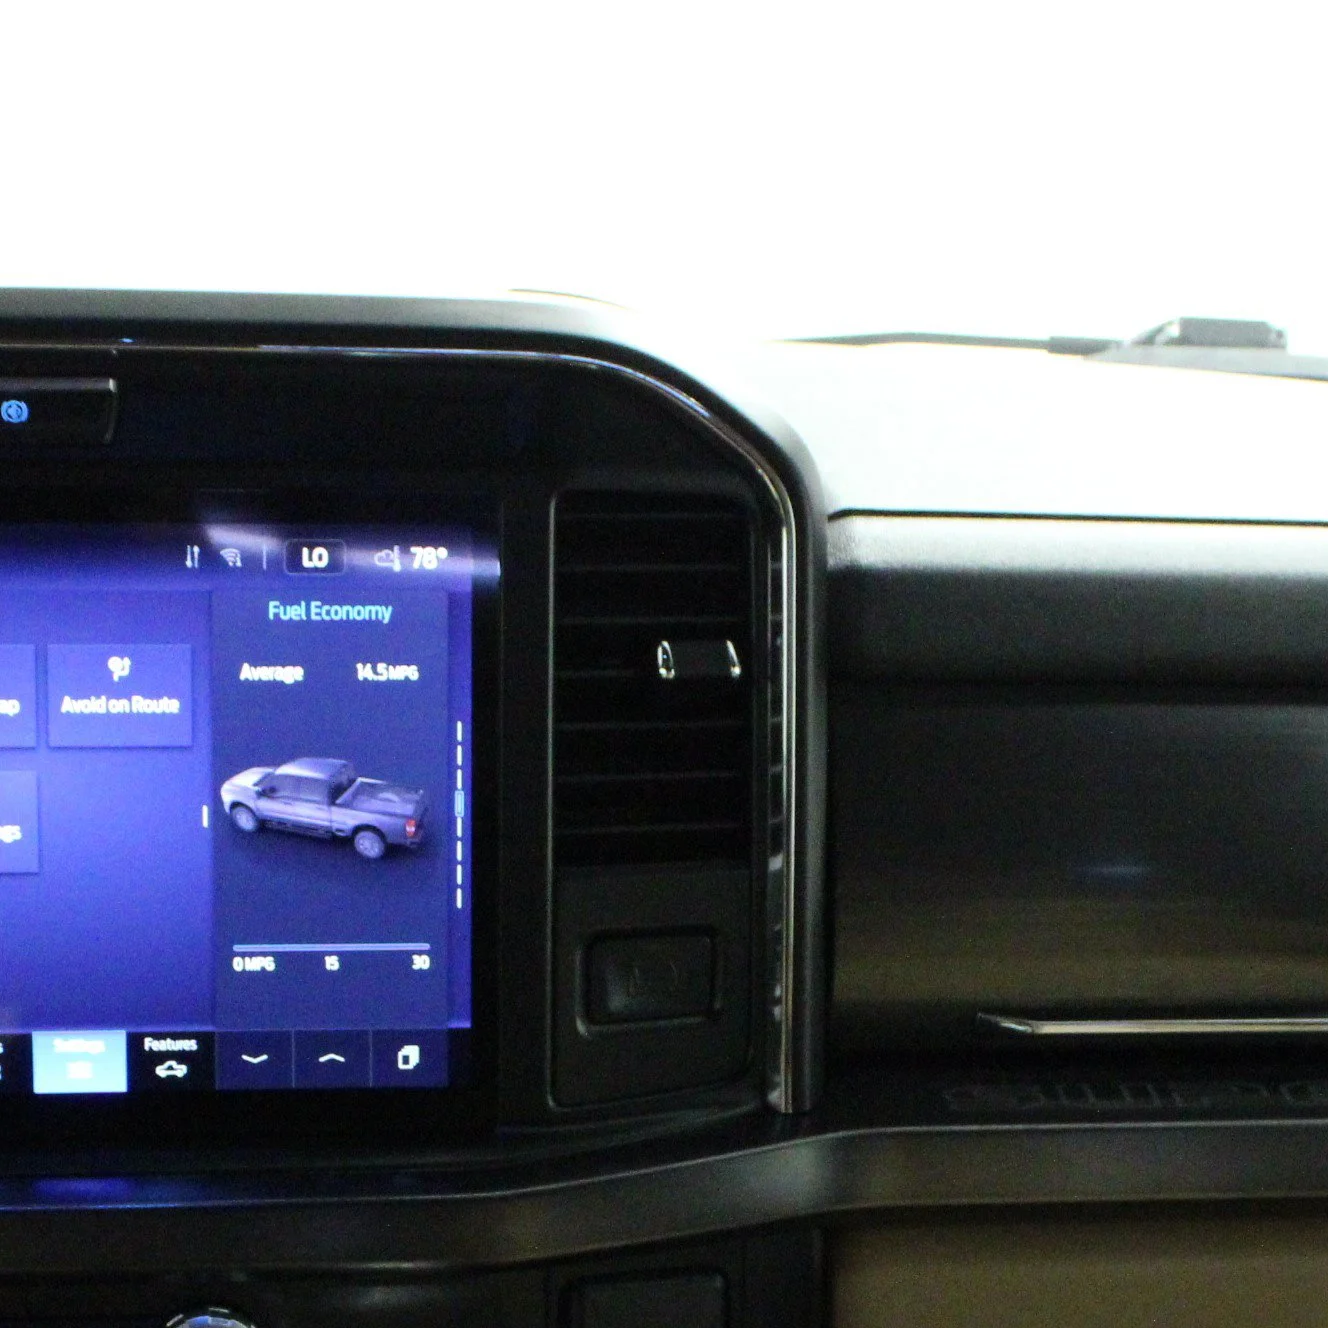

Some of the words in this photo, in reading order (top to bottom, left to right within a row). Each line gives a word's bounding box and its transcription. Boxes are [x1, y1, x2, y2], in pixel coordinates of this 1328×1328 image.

[301, 546, 329, 568] LO
[408, 546, 449, 570] 78°
[268, 600, 307, 621] Fuel
[310, 600, 393, 624] Economy
[239, 662, 305, 685] Average
[60, 695, 108, 714] Avoid
[107, 698, 131, 714] on
[130, 695, 181, 714] Route
[232, 956, 245, 972] 0
[324, 955, 340, 971] 15
[411, 954, 431, 970] 30
[143, 1036, 198, 1052] Features
